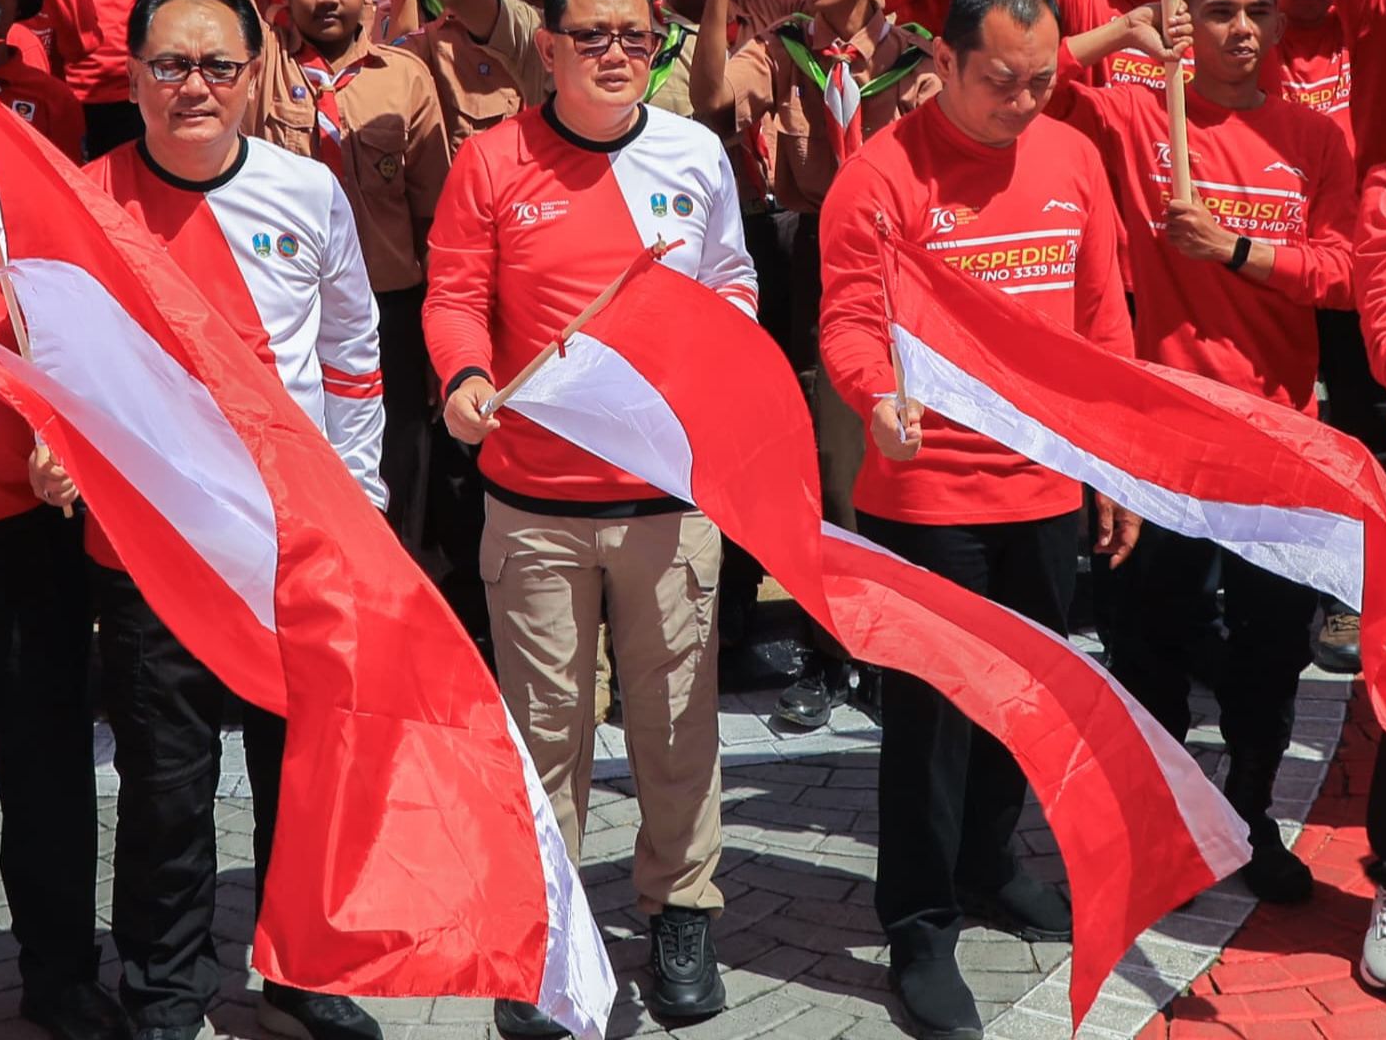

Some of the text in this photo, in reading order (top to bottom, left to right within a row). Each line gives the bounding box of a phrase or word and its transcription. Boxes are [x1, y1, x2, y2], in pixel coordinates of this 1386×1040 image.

[512, 202, 538, 225] 79
[930, 208, 955, 233] 79
[1224, 216, 1258, 230] 3339
[1260, 220, 1303, 235] MDPL
[1013, 264, 1048, 279] 3339
